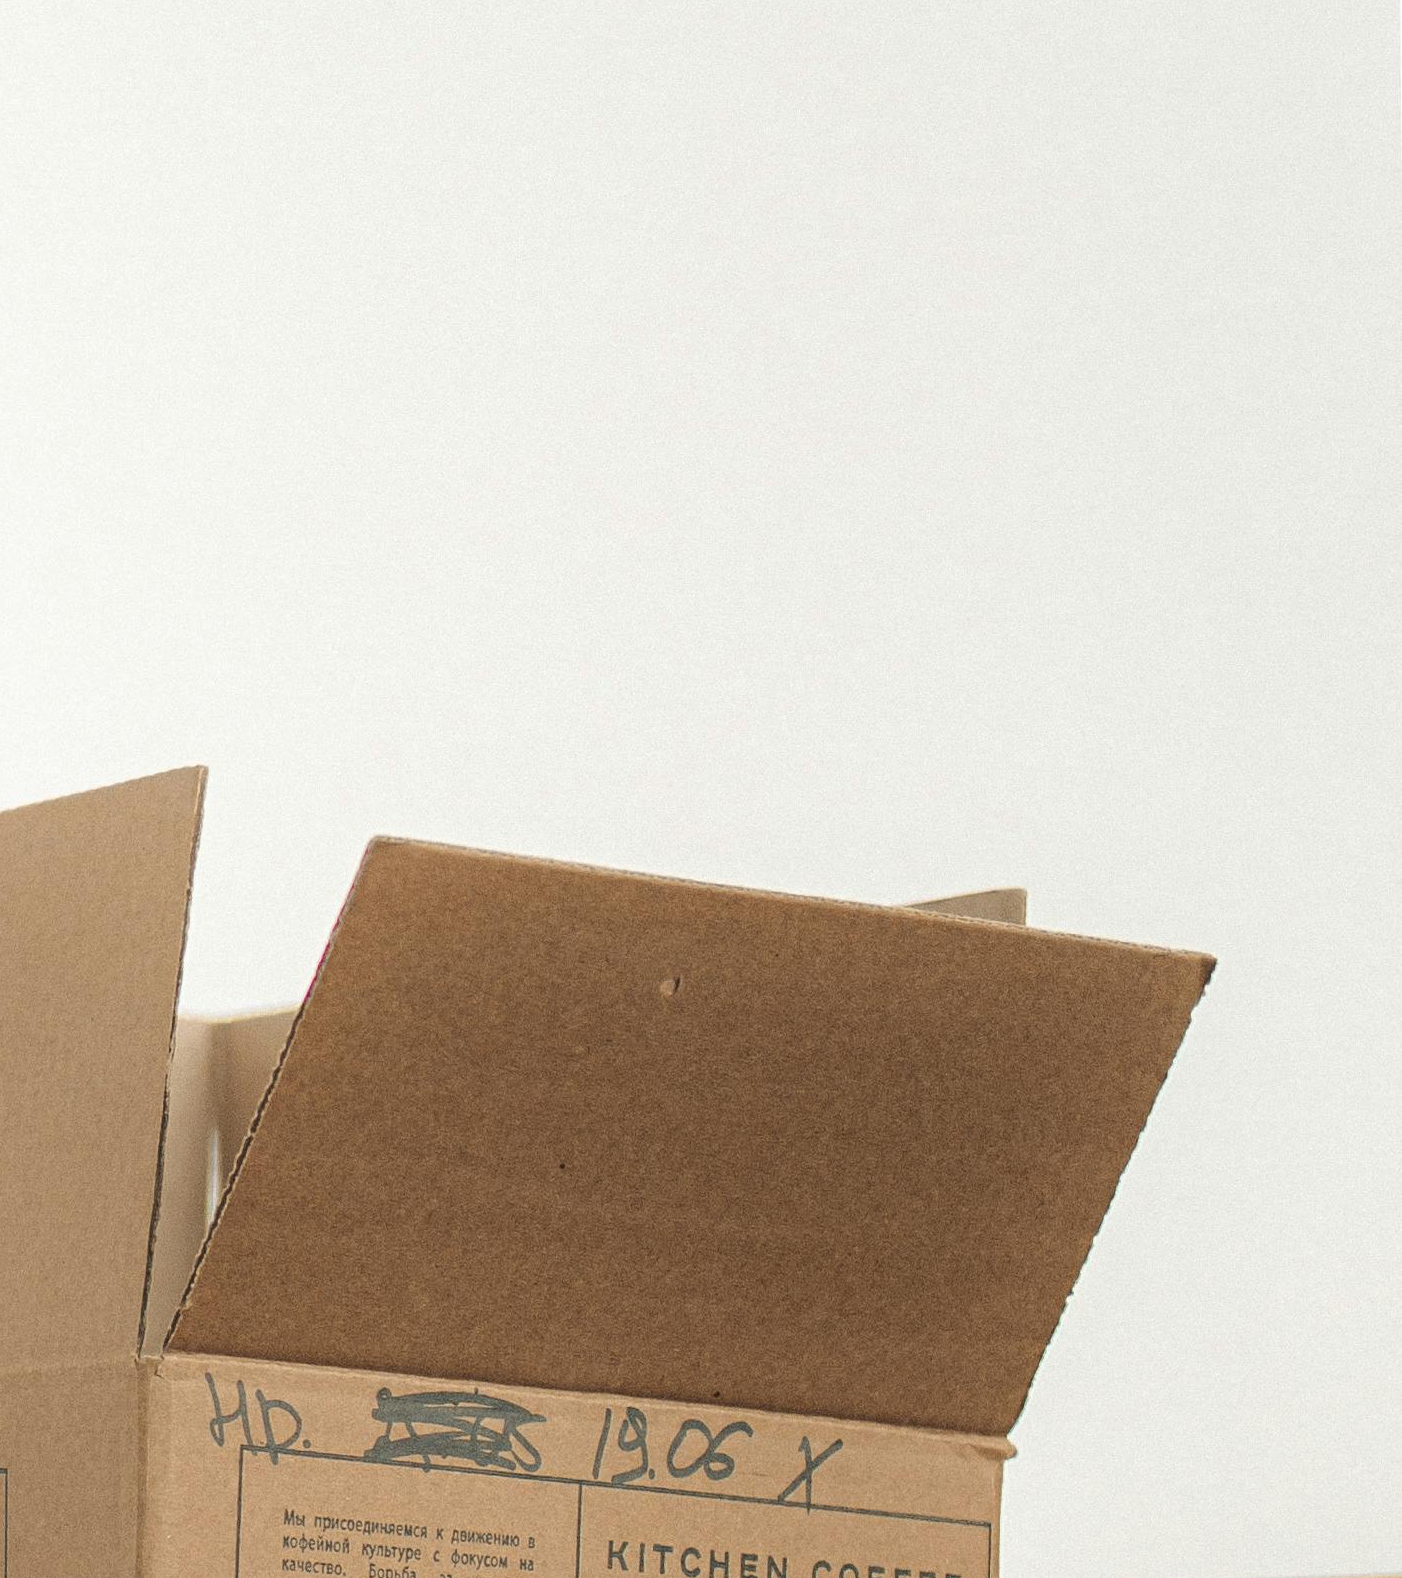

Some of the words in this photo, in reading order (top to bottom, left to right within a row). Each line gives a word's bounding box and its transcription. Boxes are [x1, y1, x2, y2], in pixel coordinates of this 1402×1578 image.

[592, 1406, 753, 1484] 19.06
[282, 1507, 306, 1527] Мы
[313, 1515, 427, 1538] присоединяемся
[434, 1527, 444, 1540] к
[450, 1528, 520, 1547] движению
[527, 1535, 535, 1549] в
[281, 1532, 350, 1554] кофейной
[360, 1542, 421, 1563] культуре
[432, 1549, 440, 1562] с
[450, 1547, 508, 1570] фокусом
[518, 1557, 534, 1571] на
[281, 1558, 346, 1577] качество.
